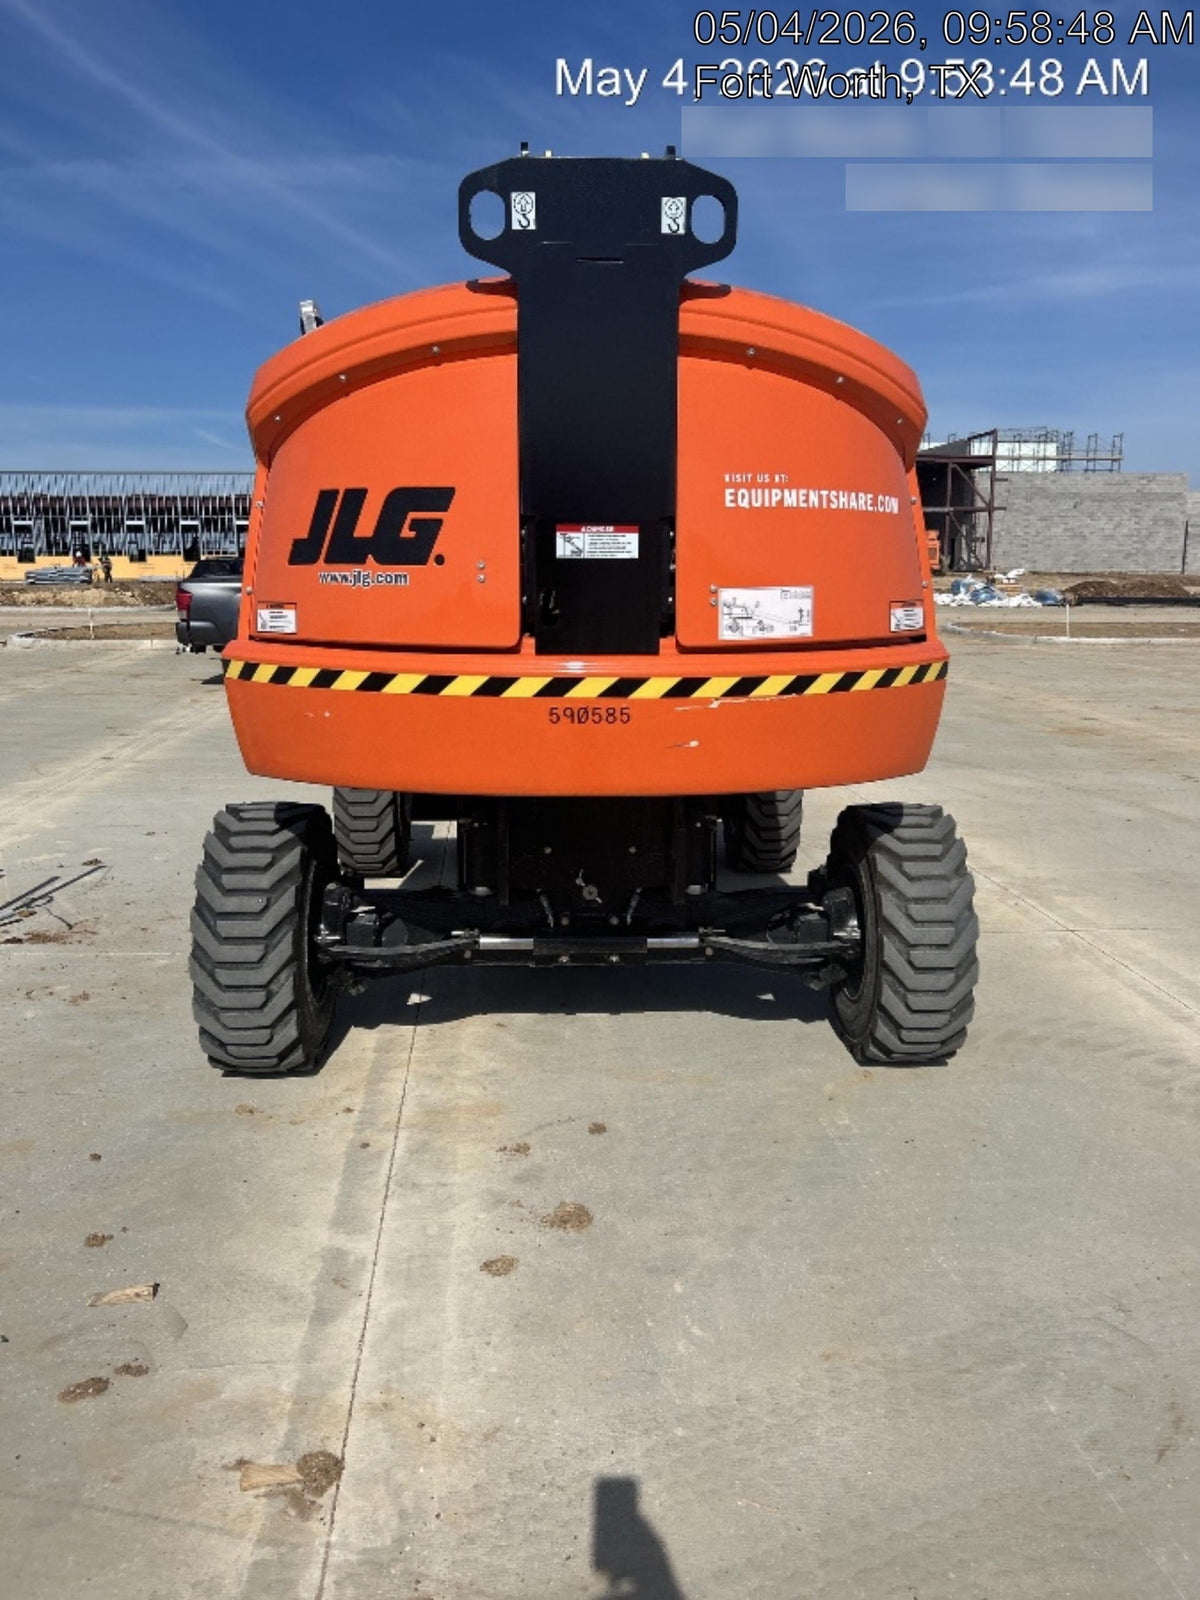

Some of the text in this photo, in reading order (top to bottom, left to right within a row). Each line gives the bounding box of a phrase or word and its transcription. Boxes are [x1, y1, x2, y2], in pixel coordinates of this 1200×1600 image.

[757, 474, 770, 483] US
[724, 488, 899, 515] EQUIPMENTSHARE.COM
[318, 569, 409, 588] www.jlg.com
[549, 707, 631, 724] 590585
